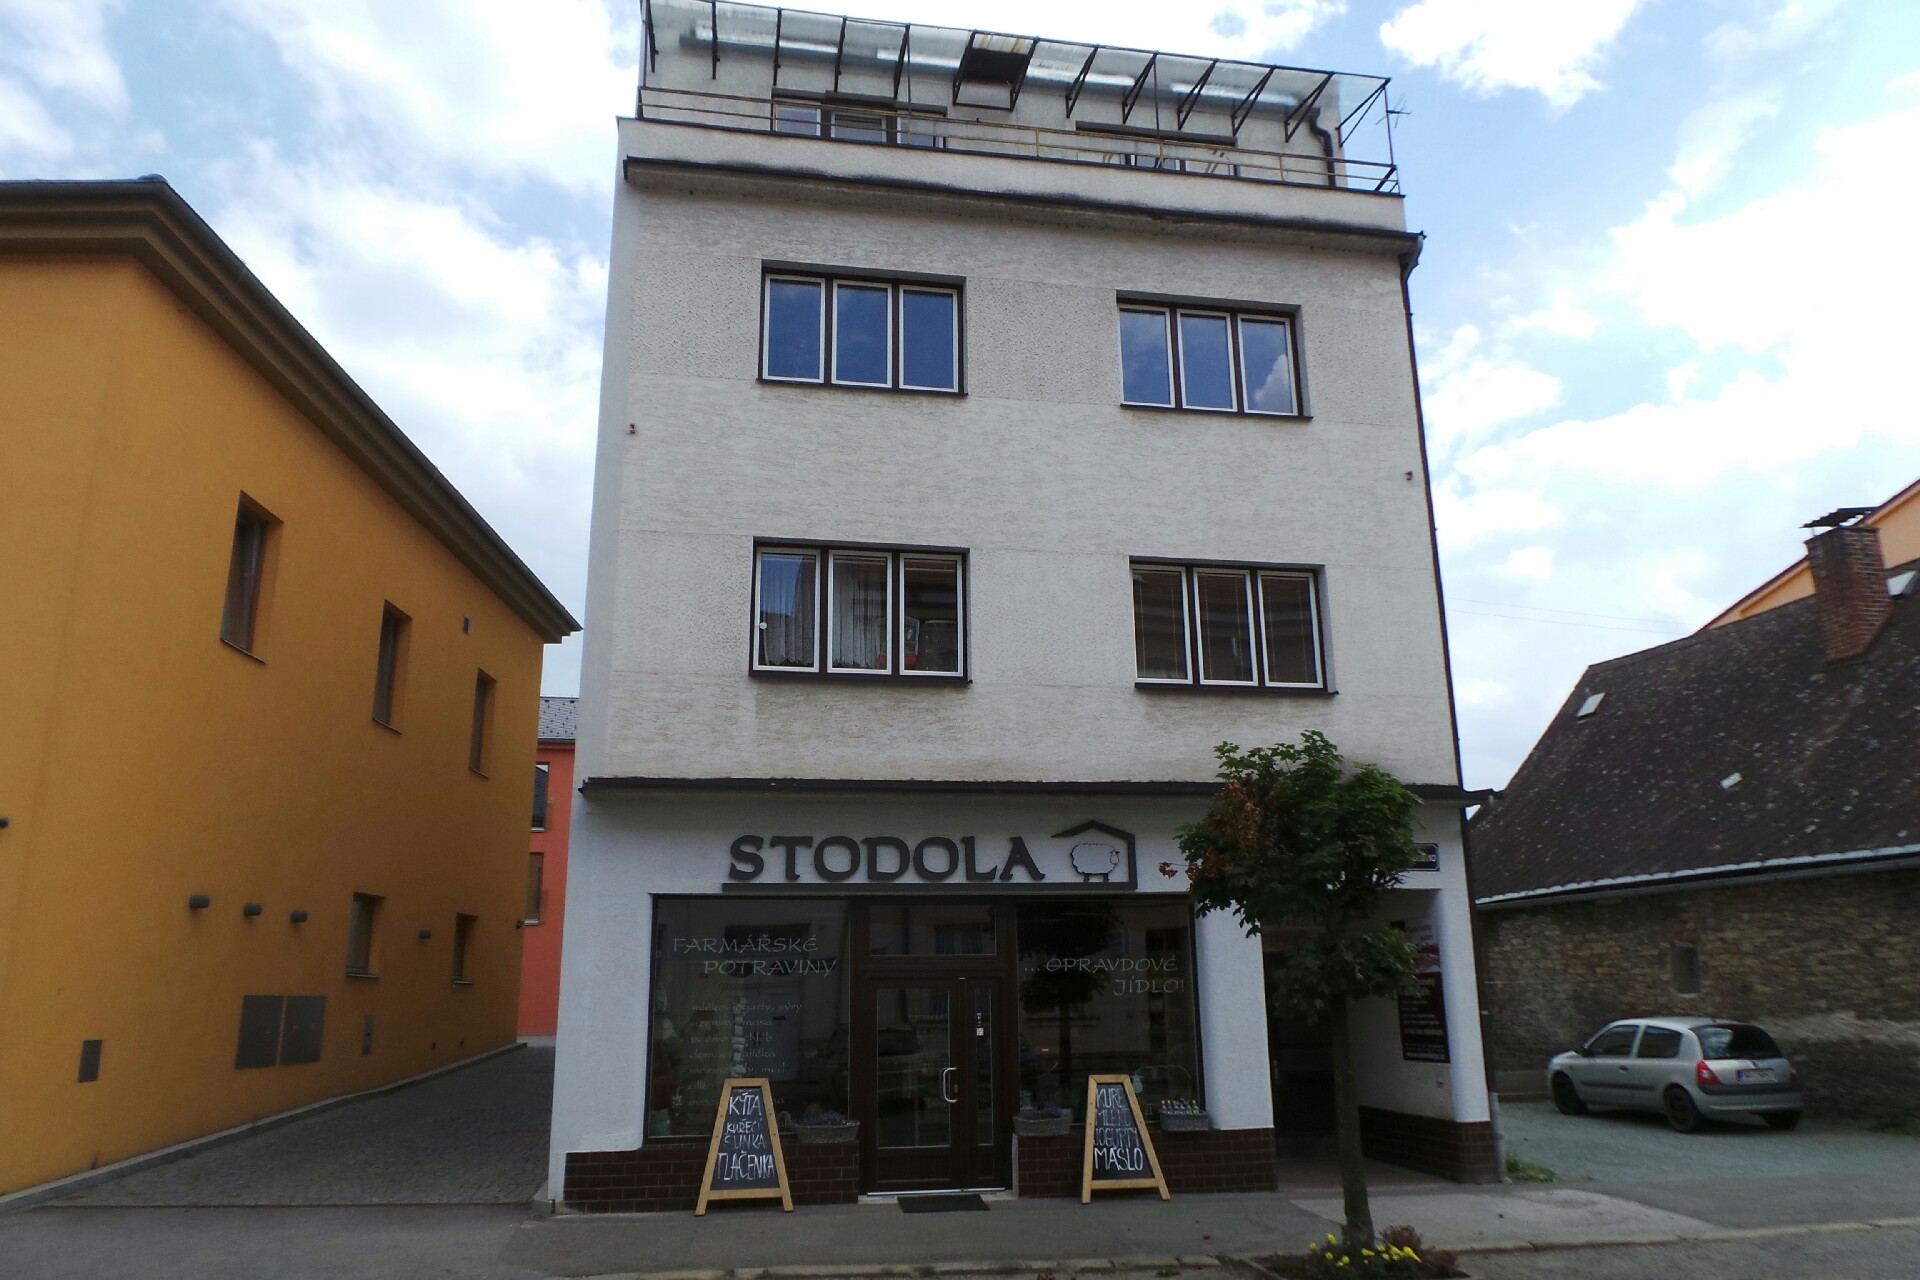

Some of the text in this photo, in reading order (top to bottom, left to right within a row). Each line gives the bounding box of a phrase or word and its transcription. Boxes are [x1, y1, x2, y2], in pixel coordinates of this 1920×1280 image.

[729, 834, 1046, 881] STODOLA
[672, 934, 819, 953] FARMÁŘSKÉ
[703, 959, 837, 977] POTRAVINY
[1113, 975, 1184, 996] JÍDLO!
[728, 1092, 763, 1116] KÝTA
[717, 1149, 775, 1182] TLAČENKA
